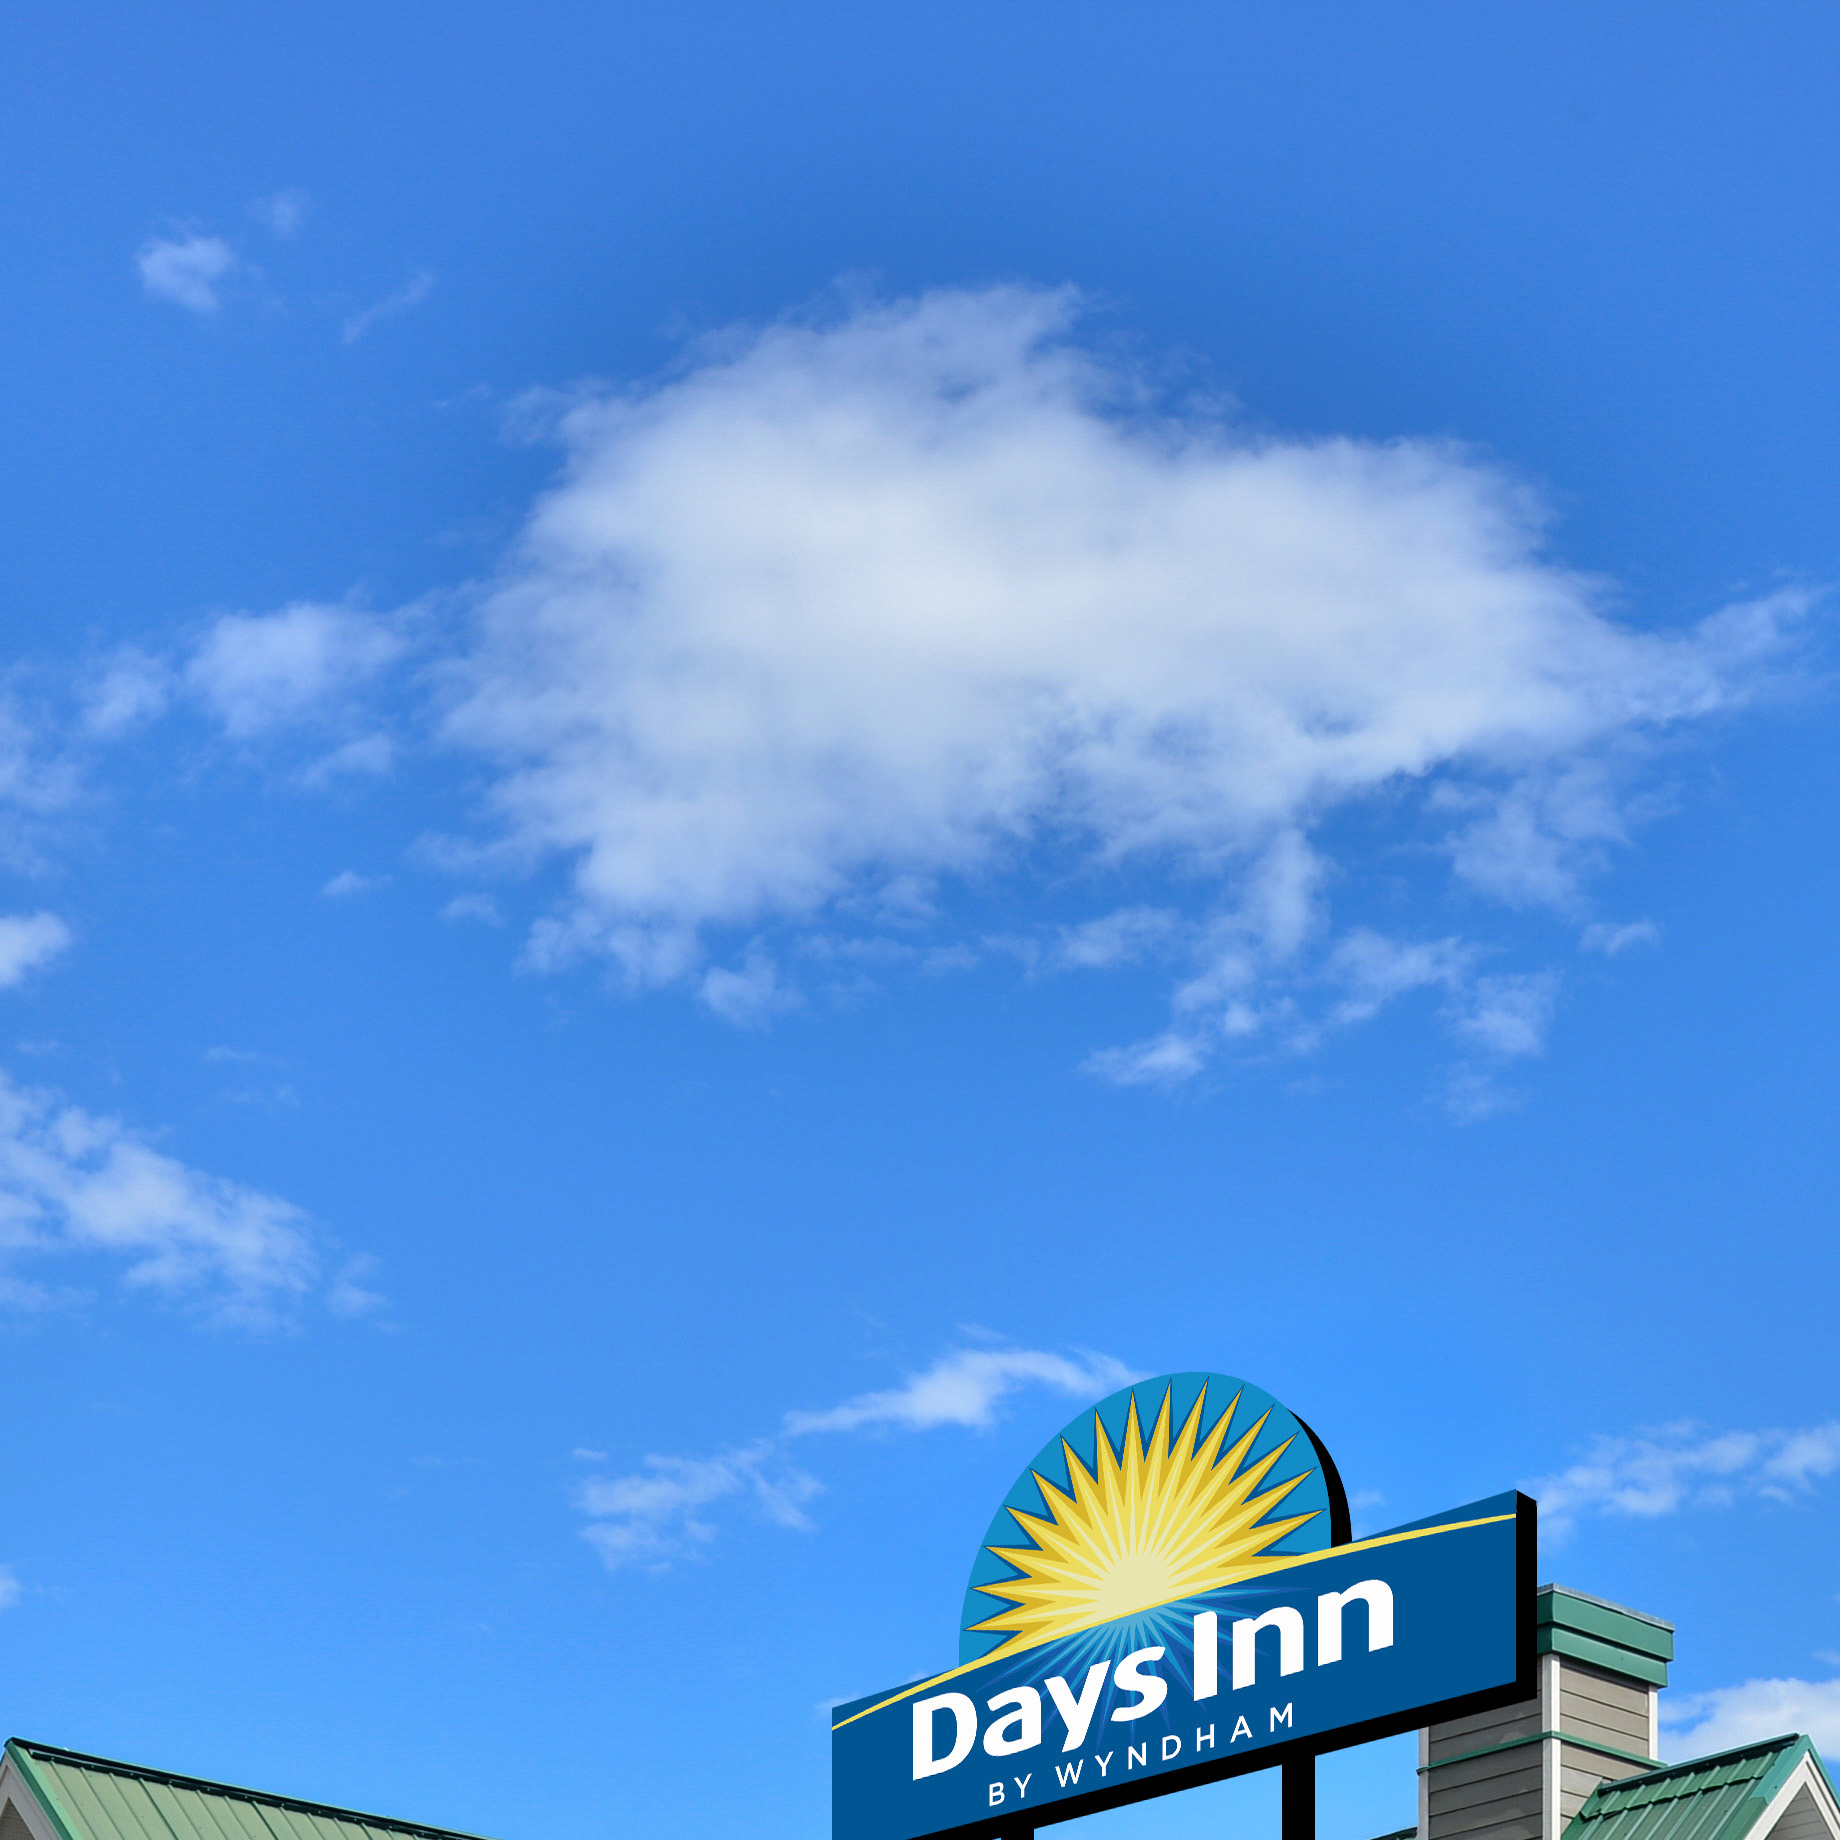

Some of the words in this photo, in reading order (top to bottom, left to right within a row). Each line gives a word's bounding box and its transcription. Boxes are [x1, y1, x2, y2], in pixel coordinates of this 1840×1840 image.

[912, 1646, 1168, 1781] Days
[1193, 1579, 1394, 1702] Inn
[989, 1773, 1033, 1807] BY
[1055, 1702, 1294, 1789] WYNDHAM
